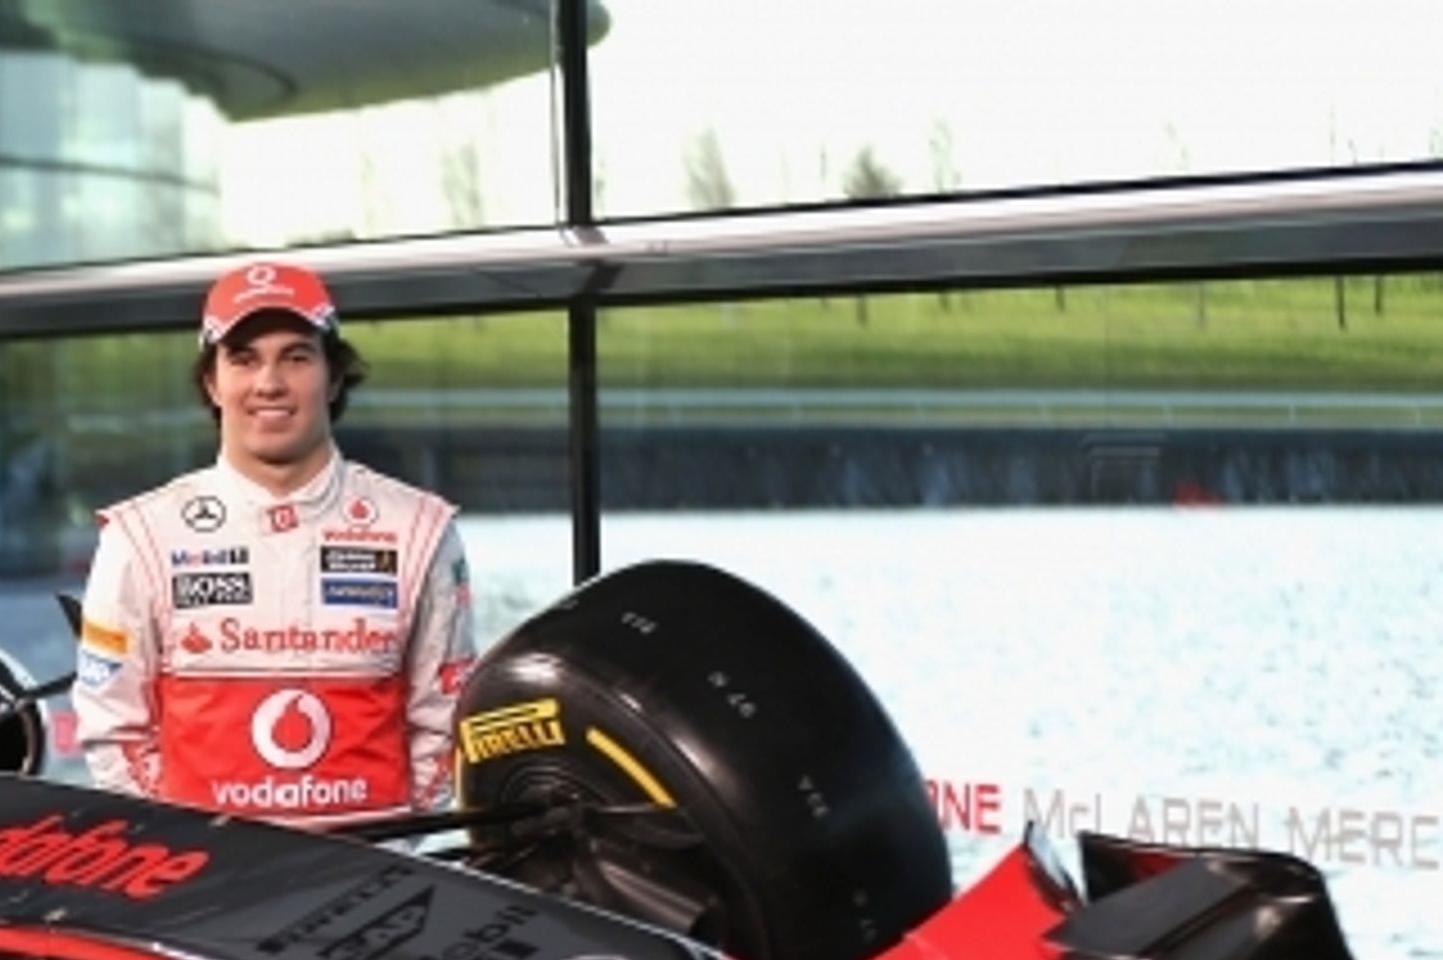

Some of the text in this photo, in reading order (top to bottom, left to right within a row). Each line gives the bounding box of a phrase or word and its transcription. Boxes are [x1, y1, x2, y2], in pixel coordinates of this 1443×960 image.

[219, 617, 396, 653] Santander
[460, 699, 565, 764] PIRELLI
[211, 776, 367, 807] vodafone
